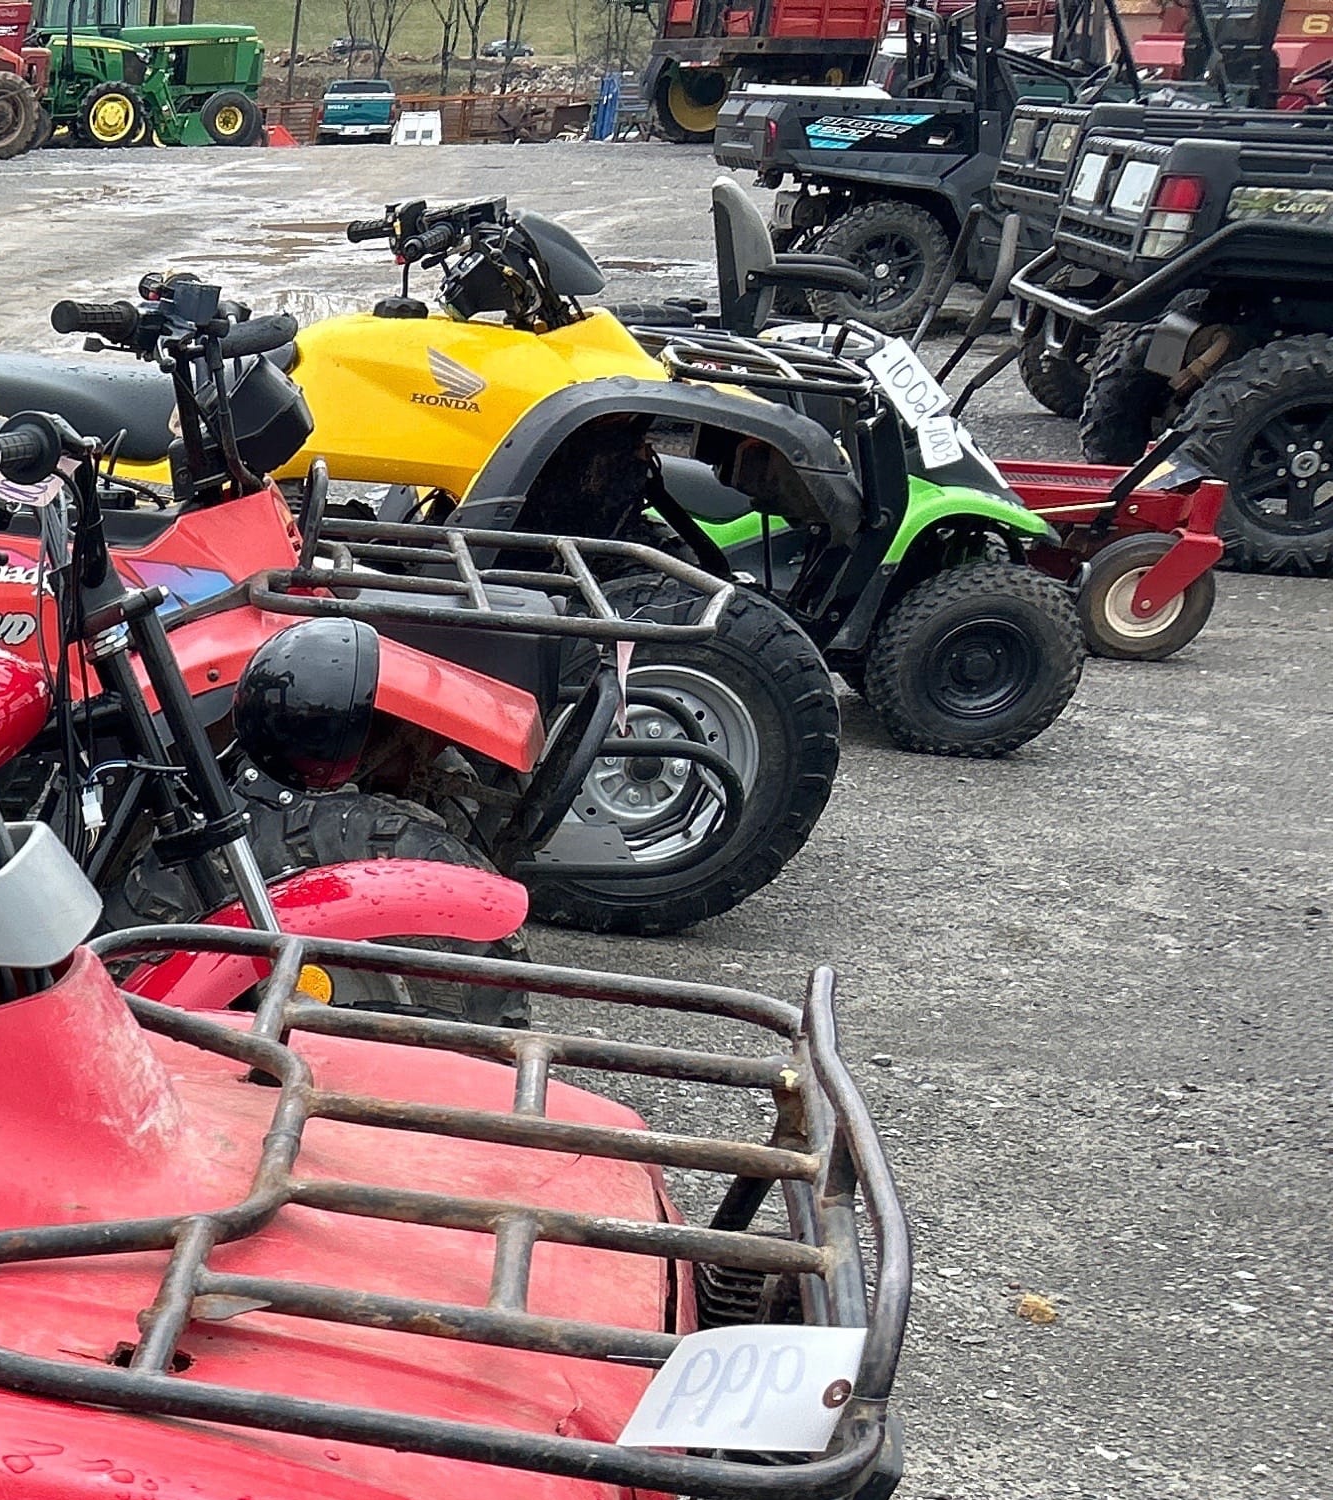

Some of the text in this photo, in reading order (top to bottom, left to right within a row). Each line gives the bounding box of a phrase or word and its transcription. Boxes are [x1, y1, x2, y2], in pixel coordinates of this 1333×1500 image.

[1273, 200, 1328, 214] GATOR
[410, 393, 482, 413] HONDA
[886, 355, 940, 421] 1002
[925, 420, 952, 462] 1003
